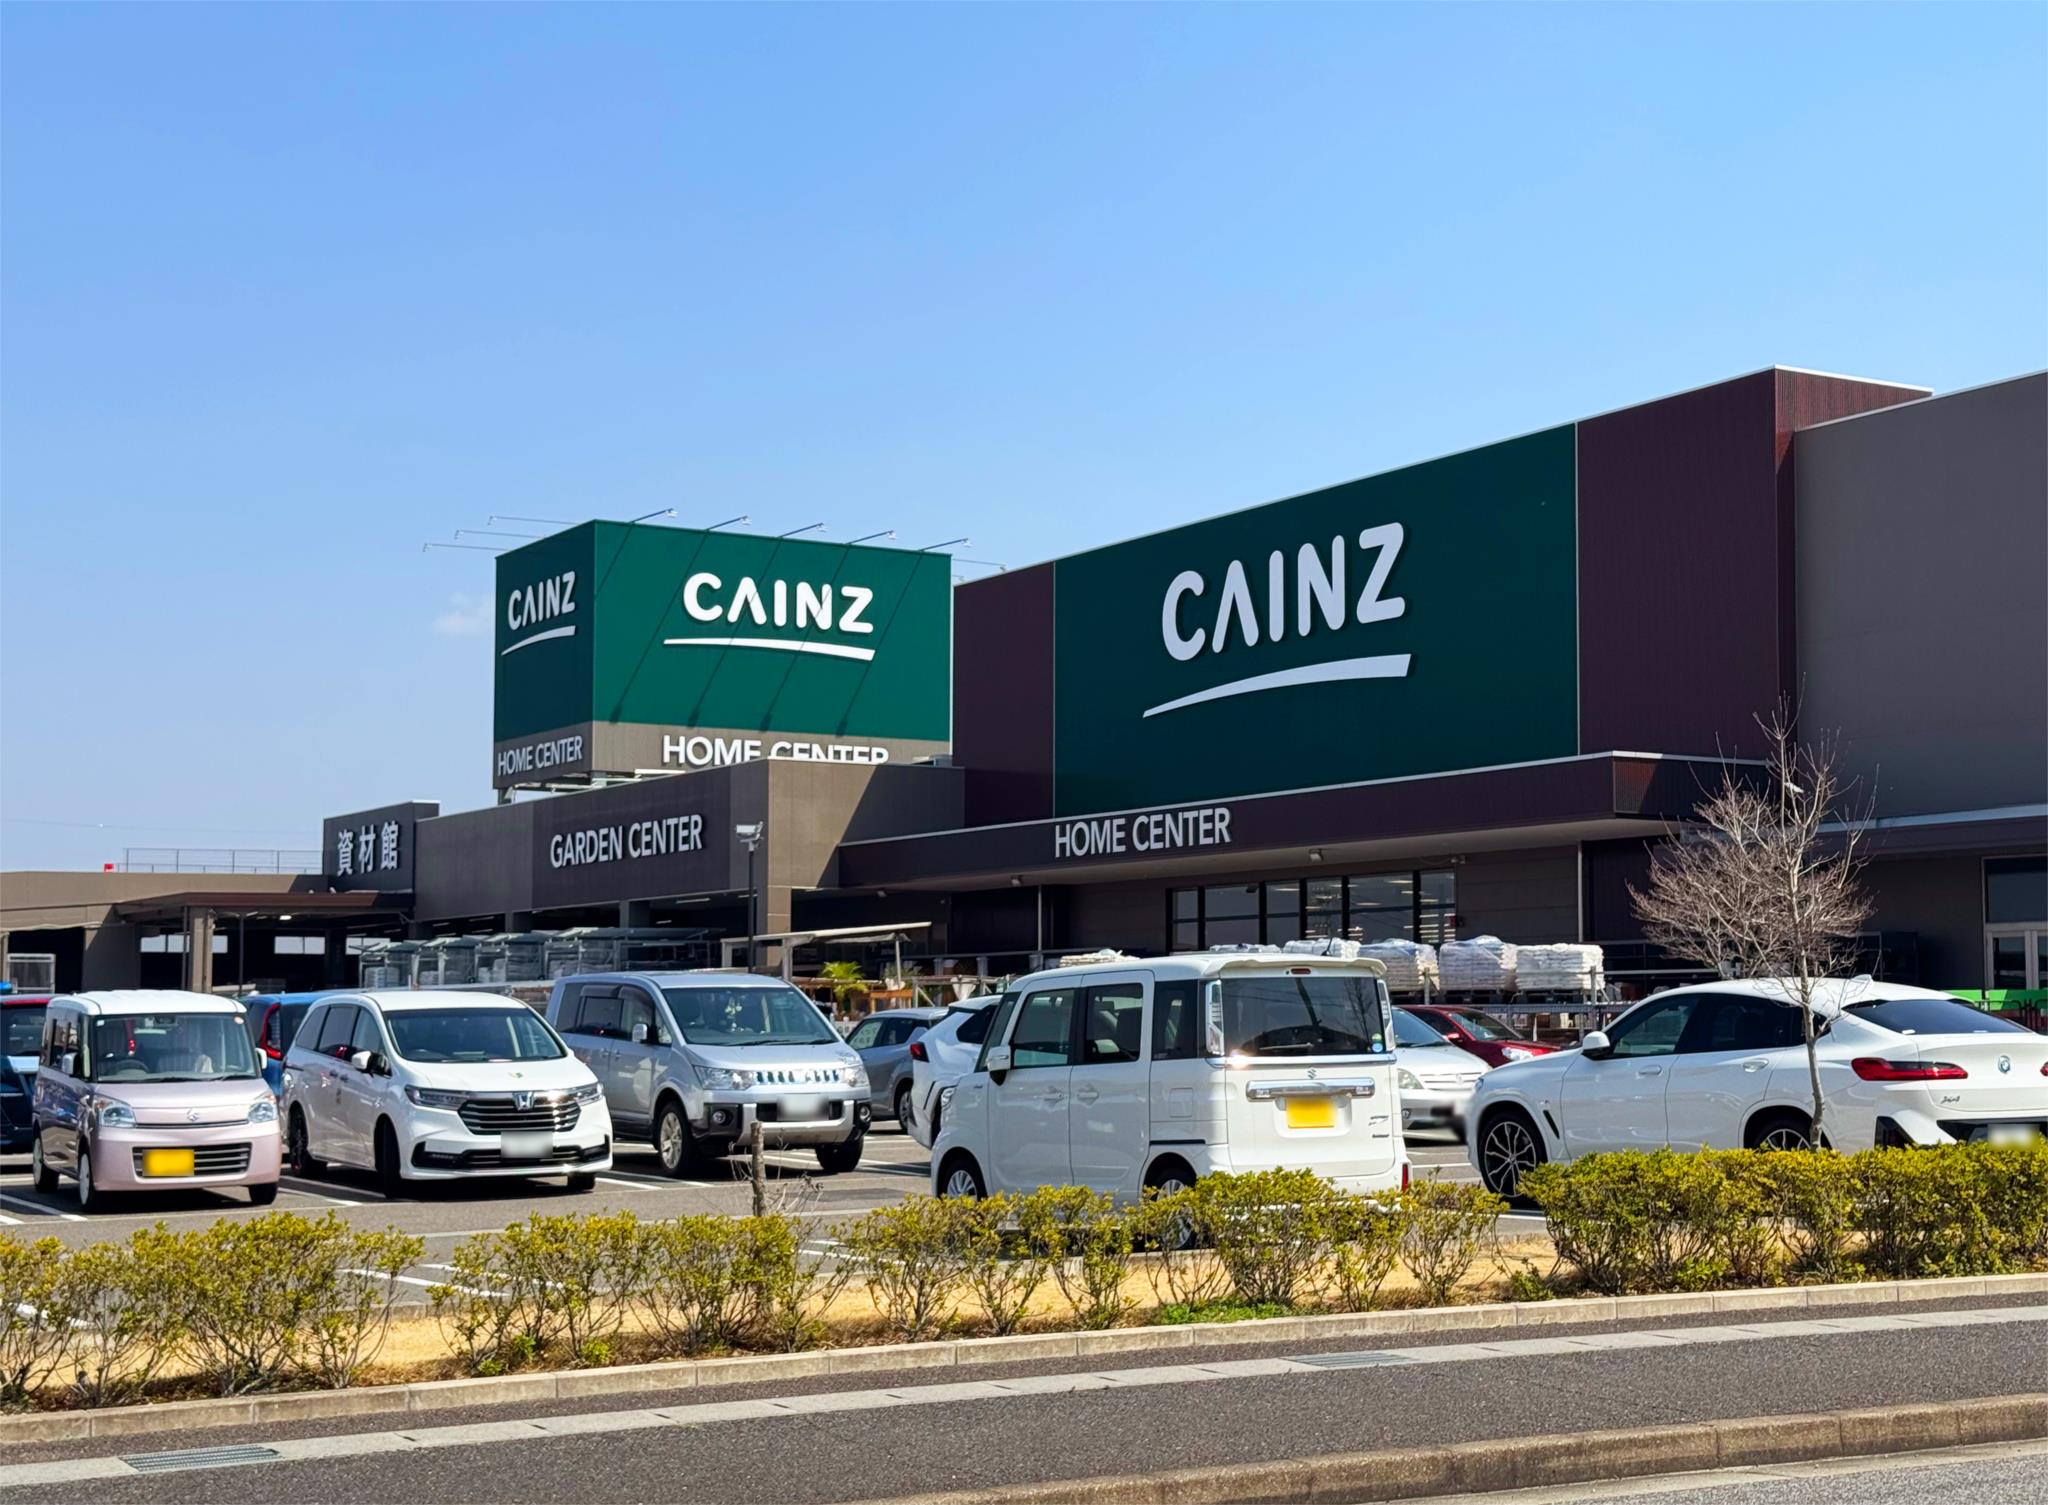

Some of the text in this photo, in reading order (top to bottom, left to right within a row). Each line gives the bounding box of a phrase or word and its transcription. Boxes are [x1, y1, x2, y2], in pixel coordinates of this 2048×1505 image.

[508, 570, 576, 631] CAINZ
[683, 572, 874, 633] CAINZ
[1162, 522, 1406, 661] CAINZ
[498, 735, 583, 776] HOME CENTER
[337, 820, 399, 876] 資材館
[550, 814, 703, 868] GARDEN CENTER
[1055, 807, 1232, 858] HOME CENTER
